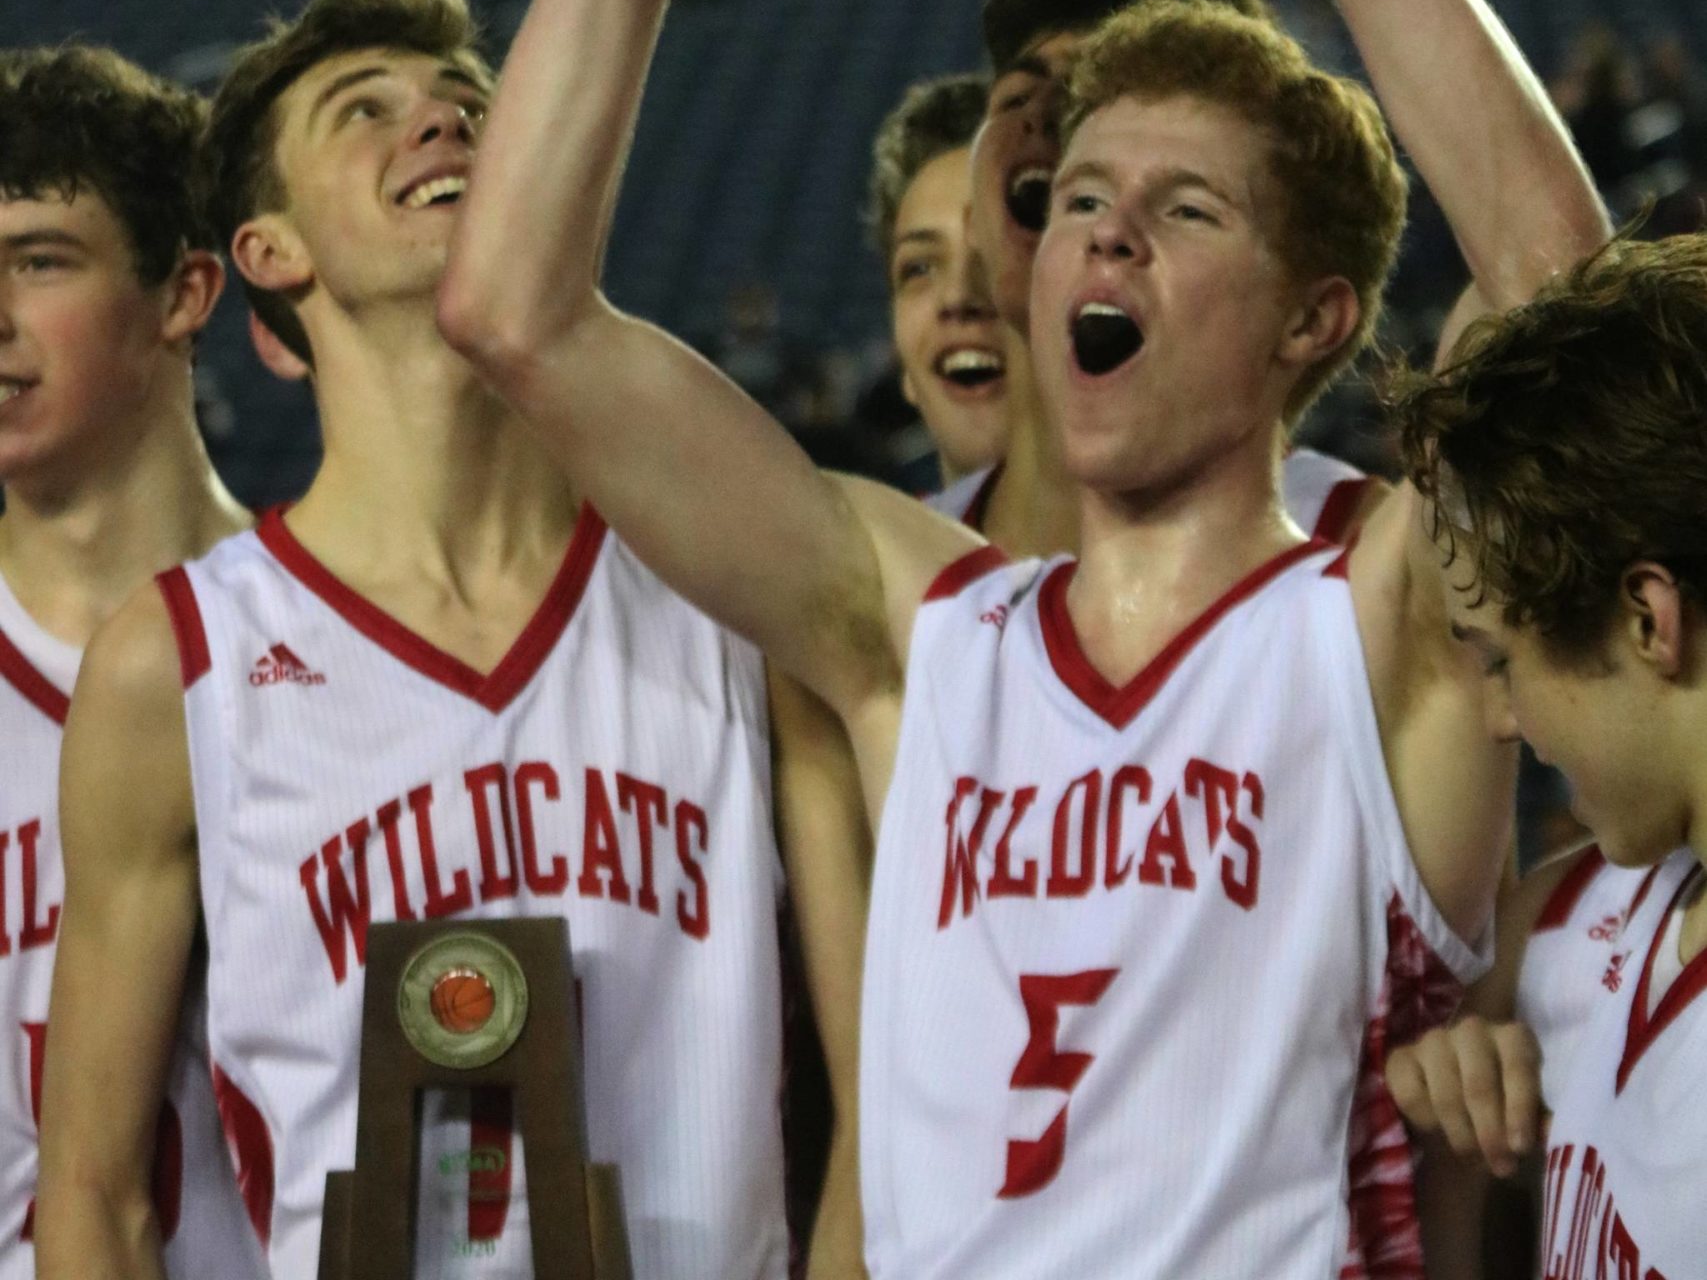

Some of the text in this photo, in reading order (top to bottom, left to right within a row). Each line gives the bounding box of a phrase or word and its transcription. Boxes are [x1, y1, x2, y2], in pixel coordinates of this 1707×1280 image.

[300, 761, 711, 986] WILDCATS
[936, 756, 1264, 931] WLDCATS
[997, 967, 1121, 1199] 5
